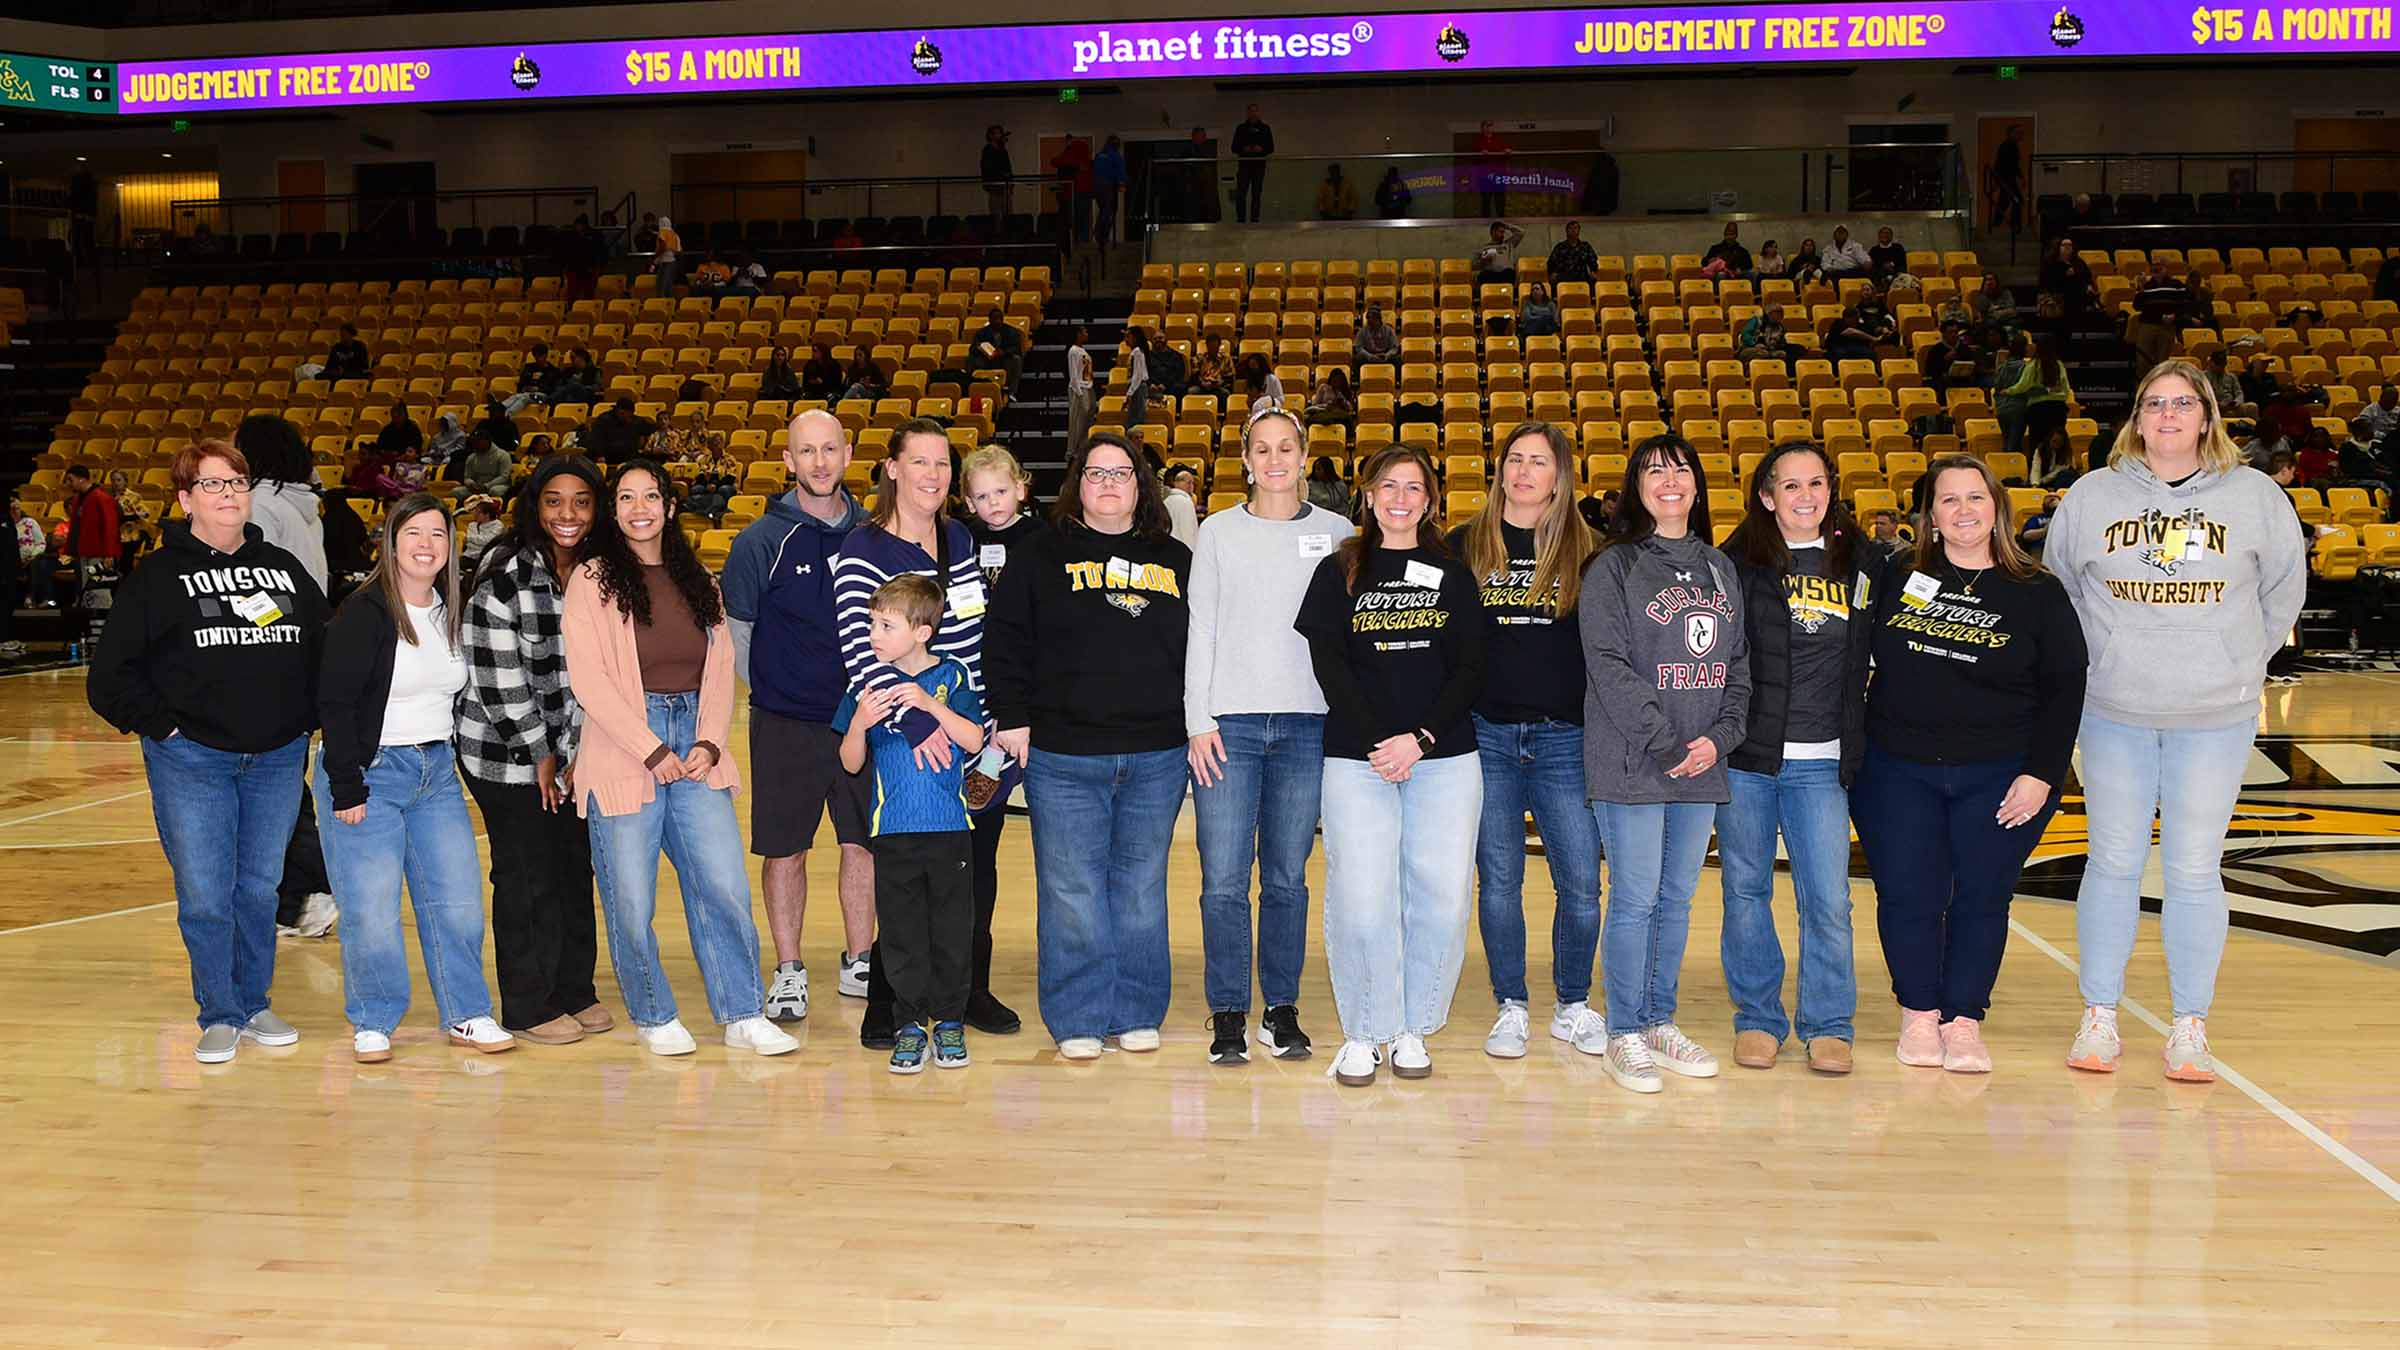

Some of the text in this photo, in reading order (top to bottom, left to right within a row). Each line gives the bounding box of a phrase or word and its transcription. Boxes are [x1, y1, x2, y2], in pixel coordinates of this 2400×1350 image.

[1575, 19, 1755, 53] JUDGEMENT
[1764, 17, 1839, 49] FREE
[2191, 6, 2392, 45] $15 A MONTH
[1072, 30, 1202, 73] planet
[49, 65, 102, 79] TOL 4
[625, 47, 800, 86] $15 A MONTH
[51, 86, 102, 100] FLS 0
[123, 68, 271, 103] JUDGEMENT
[279, 64, 342, 96] FREE
[2104, 515, 2227, 554] TOWN
[179, 566, 296, 597] TOWSON
[2105, 580, 2226, 604] UNIVERSITY
[1354, 590, 1441, 611] FUTURE
[1352, 608, 1450, 633] TEACHERS
[1496, 616, 1510, 625] TU
[1886, 612, 2012, 648] TEACHERS
[194, 625, 302, 648] UNIVERSITY
[1374, 641, 1388, 651] TU
[1907, 640, 1923, 652] TU
